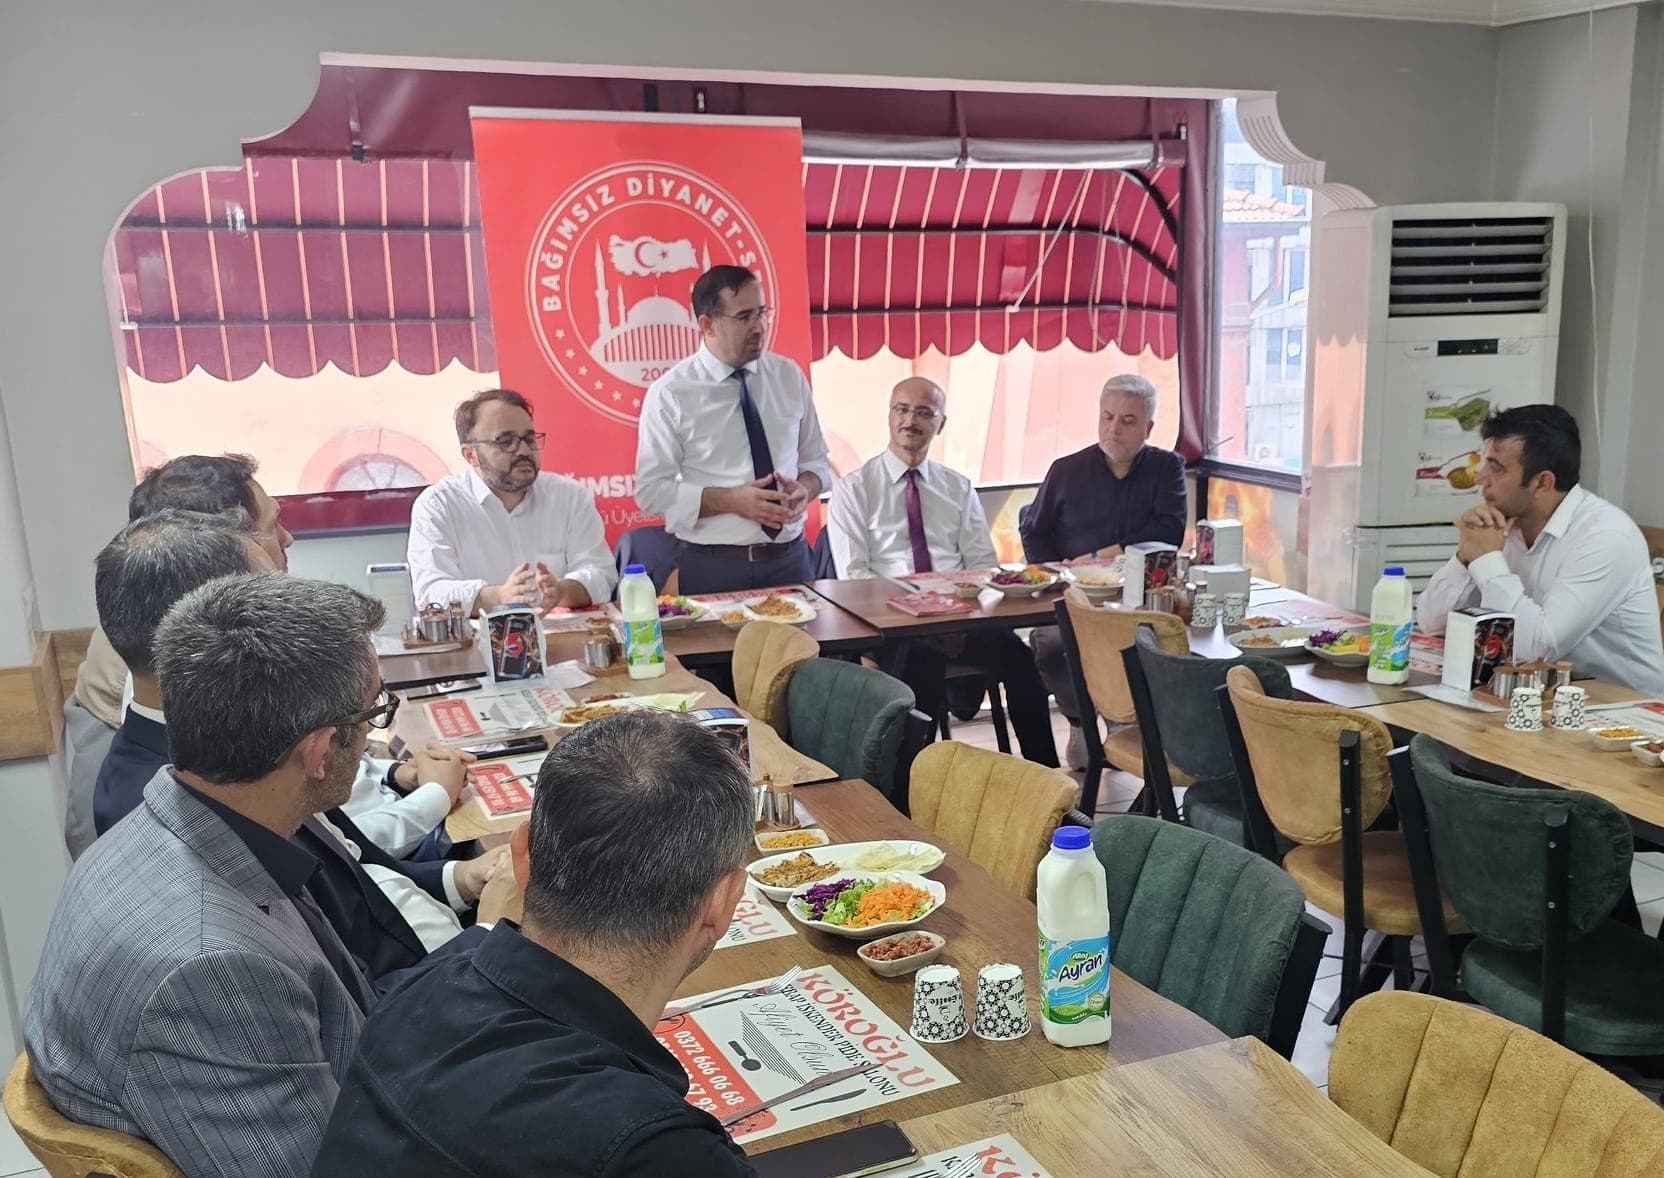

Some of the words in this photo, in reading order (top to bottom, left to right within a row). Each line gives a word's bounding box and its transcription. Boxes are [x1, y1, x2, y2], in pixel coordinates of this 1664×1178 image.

[541, 184, 615, 312] BAĞIMSIZ
[1058, 952, 1103, 983] Ayran
[749, 1003, 804, 1037] Afiyet
[796, 973, 936, 1087] KÖROĞLU
[673, 1030, 705, 1056] 0372
[836, 1037, 865, 1062] PİDE
[692, 1056, 721, 1075] 666
[709, 1075, 733, 1091] 06
[720, 1090, 747, 1106] 68
